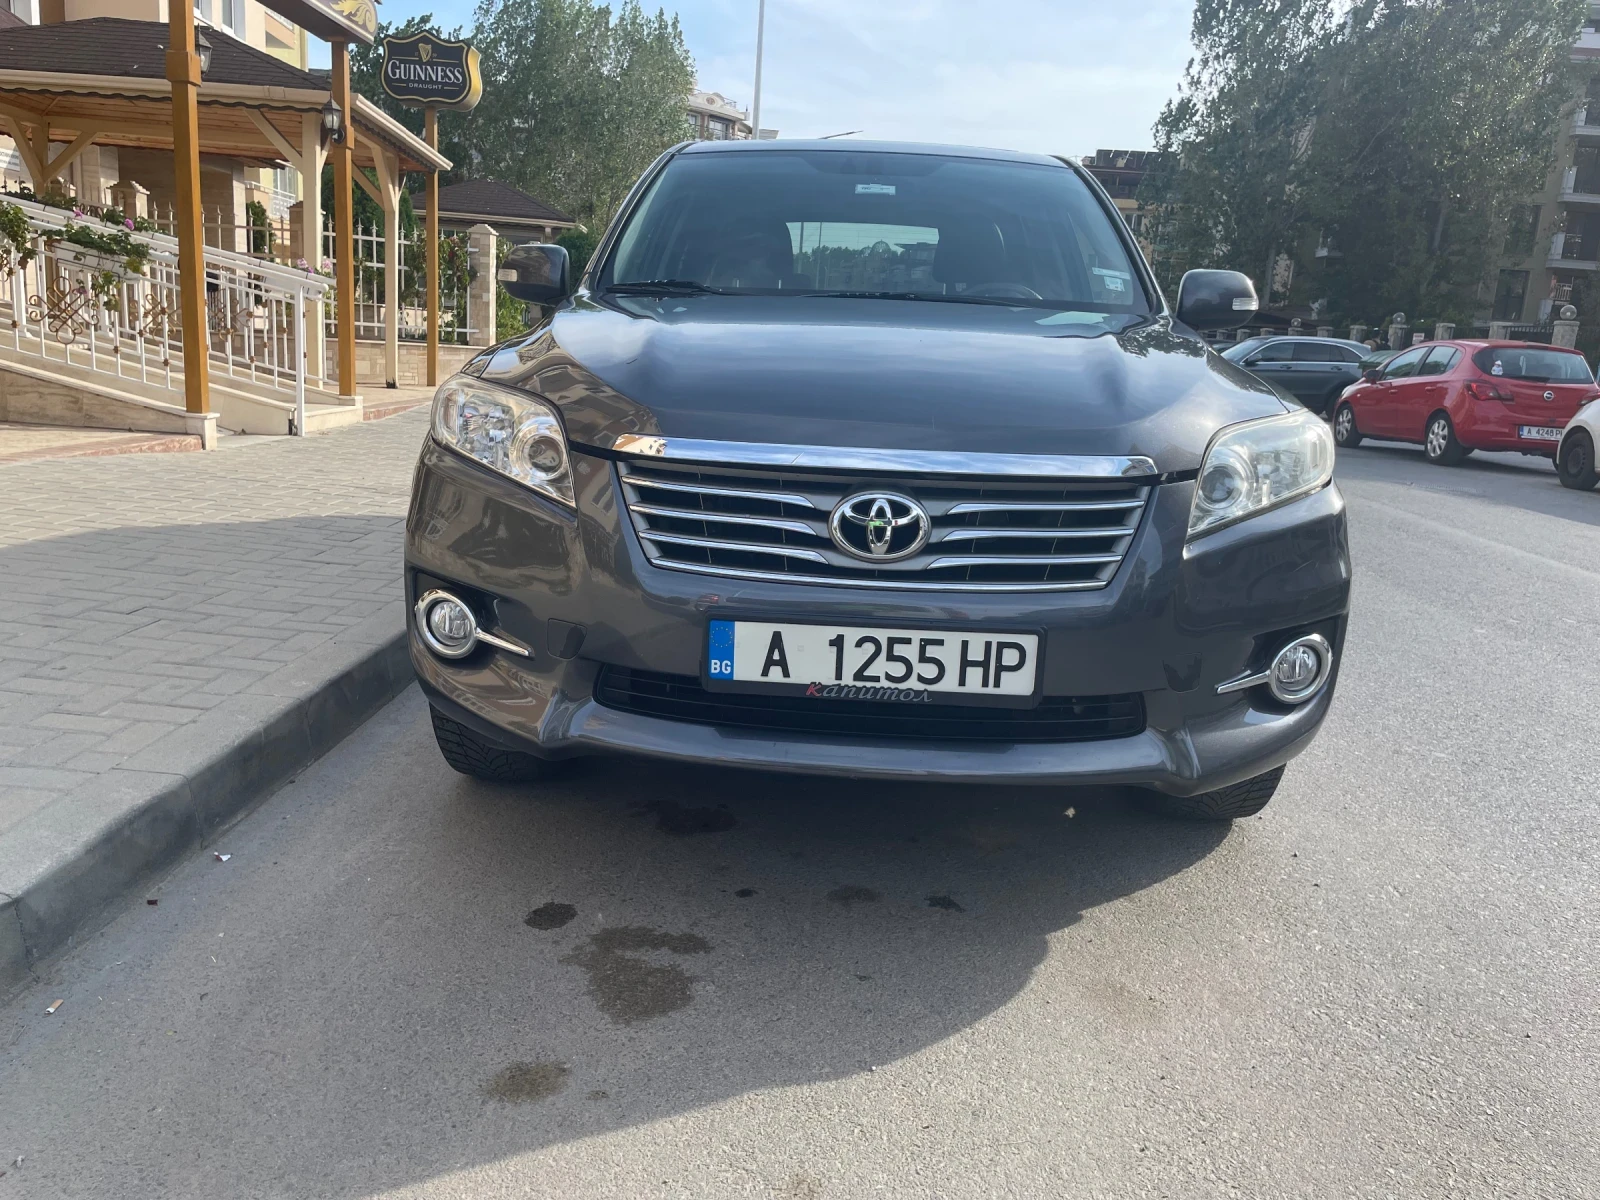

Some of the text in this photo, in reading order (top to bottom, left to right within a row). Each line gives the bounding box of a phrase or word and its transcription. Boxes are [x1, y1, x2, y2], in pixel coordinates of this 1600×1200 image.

[388, 60, 462, 83] GUINNESS
[711, 660, 731, 674] BG
[761, 631, 1027, 688] A 1255 HP
